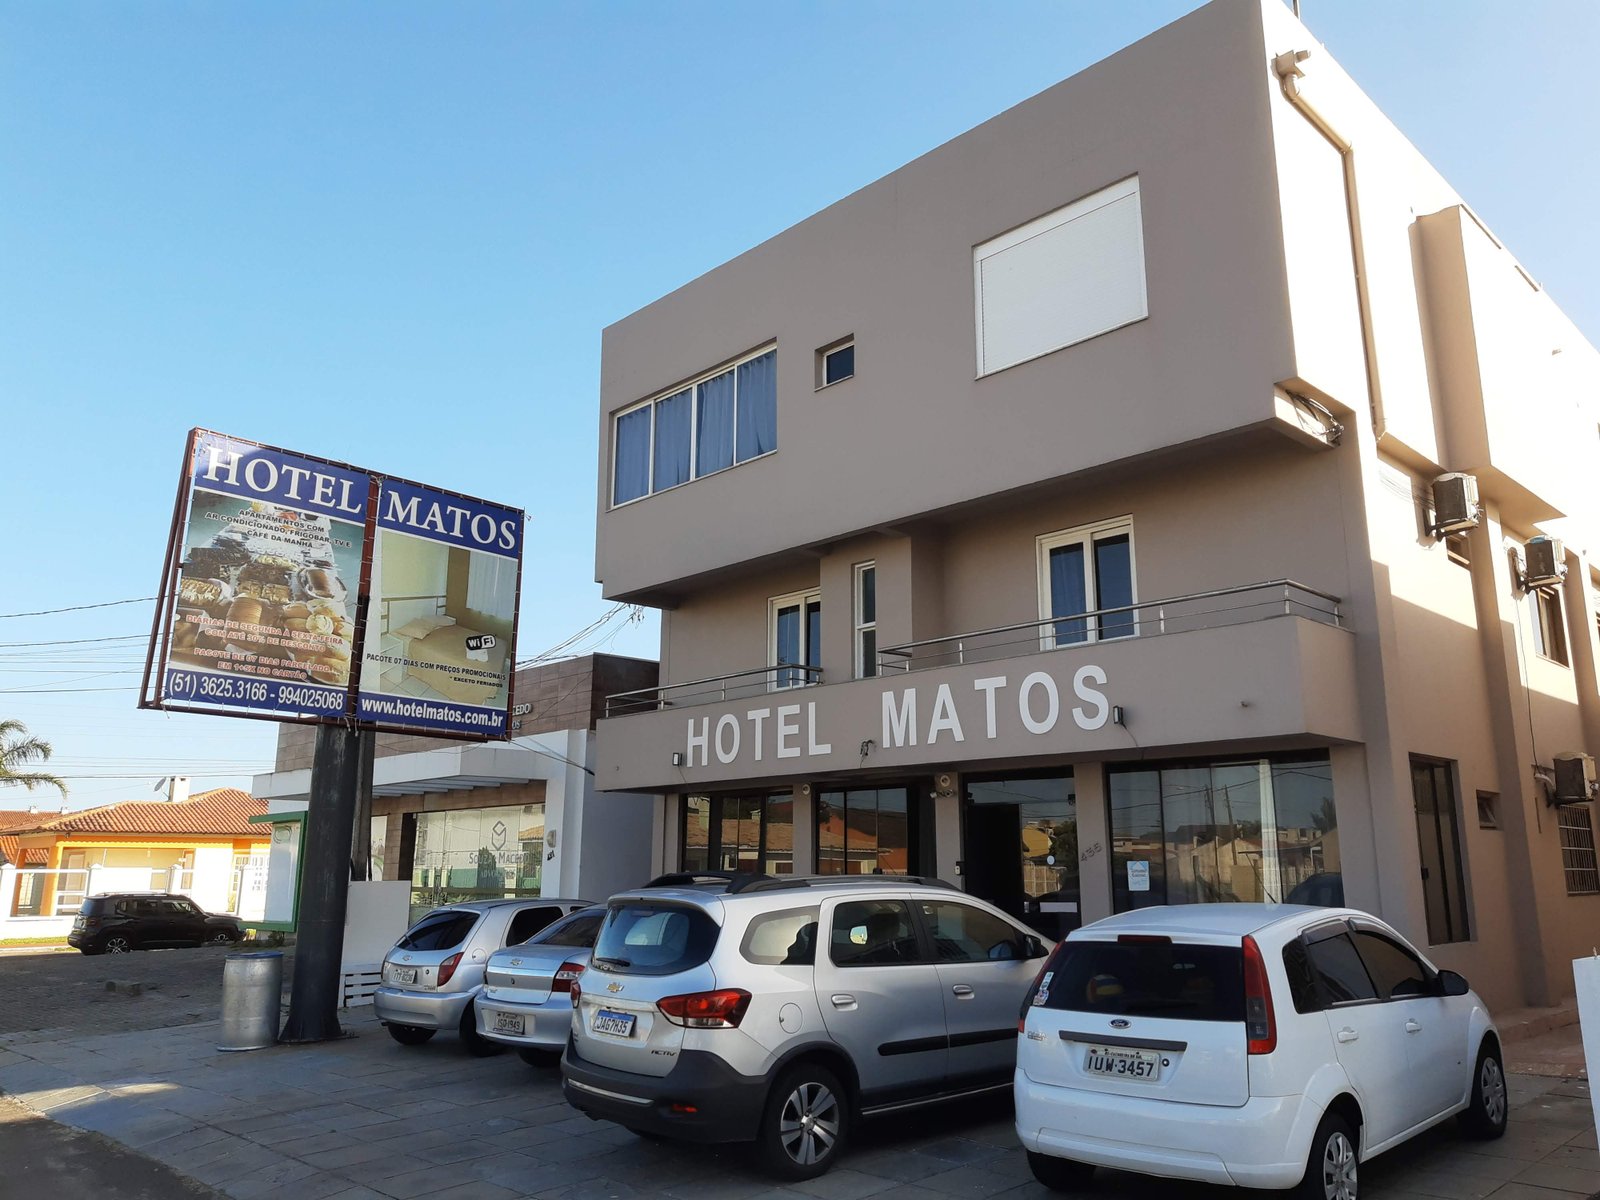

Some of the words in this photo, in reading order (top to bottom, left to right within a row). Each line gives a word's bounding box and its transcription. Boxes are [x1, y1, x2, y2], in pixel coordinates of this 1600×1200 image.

[202, 446, 362, 514] HOTEL
[383, 489, 516, 550] MATOS
[205, 512, 218, 520] AR
[239, 509, 305, 529] APARTAMENTOS
[307, 523, 324, 533] COM
[271, 533, 283, 542] DA
[204, 628, 227, 638] COM
[246, 633, 265, 644] 30%
[266, 636, 279, 645] DE
[280, 638, 326, 653] DESCONTO
[225, 621, 239, 630] DE
[239, 622, 282, 636] SEGUNDA
[193, 647, 230, 660] PACOTE
[231, 652, 245, 661] DE
[245, 654, 258, 662] 07
[258, 655, 280, 666] DIAS
[217, 661, 232, 670] EM
[257, 665, 271, 675] NO
[366, 653, 393, 664] PACOTE
[393, 657, 402, 665] 07
[403, 659, 419, 667] DIAS
[419, 661, 435, 669] COM
[435, 664, 461, 674] PREÇOS
[461, 667, 507, 681] PROMOCIONAIS
[169, 672, 197, 697] (51)
[200, 676, 268, 701] 3625.3166
[278, 686, 343, 710] 994025068
[361, 698, 503, 728] www.hotelmatos.com.br
[686, 701, 832, 769] HOTEL
[882, 664, 1110, 749] MATOS
[596, 1017, 629, 1034] JAG7H35
